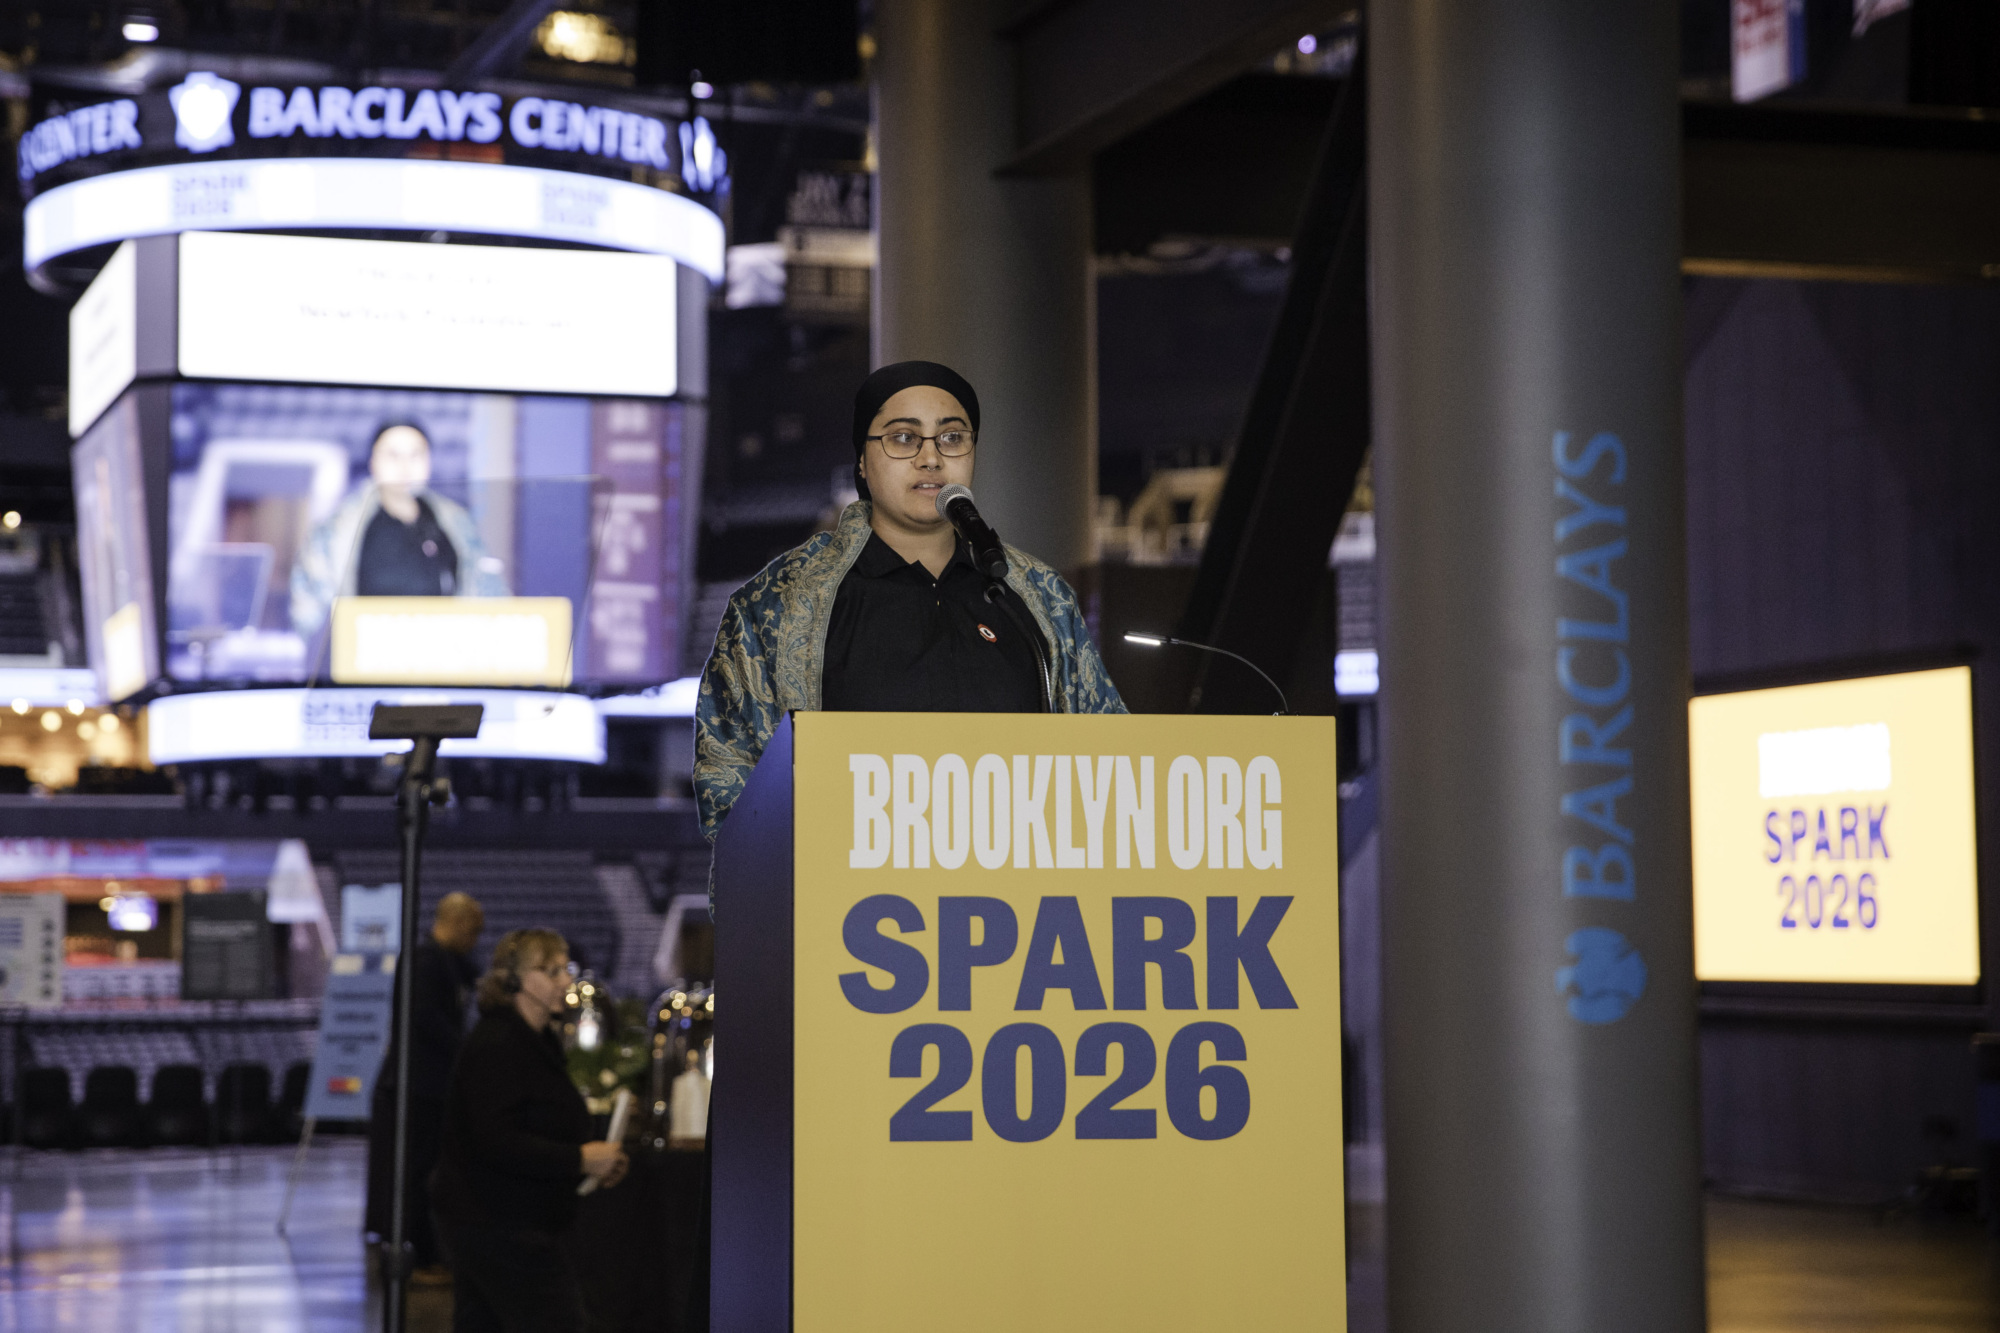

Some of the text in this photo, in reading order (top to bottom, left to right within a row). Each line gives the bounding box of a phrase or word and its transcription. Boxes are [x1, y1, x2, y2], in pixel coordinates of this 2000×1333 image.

[248, 86, 670, 170] BARCLAYS CENTER
[1552, 430, 1637, 902] BARCLAYS
[848, 753, 1283, 870] BROOKLYN ORG
[1763, 804, 1890, 864] SPARK
[838, 893, 1300, 1015] SPARK
[1778, 872, 1878, 929] 2026
[888, 1021, 1251, 1143] 2026
